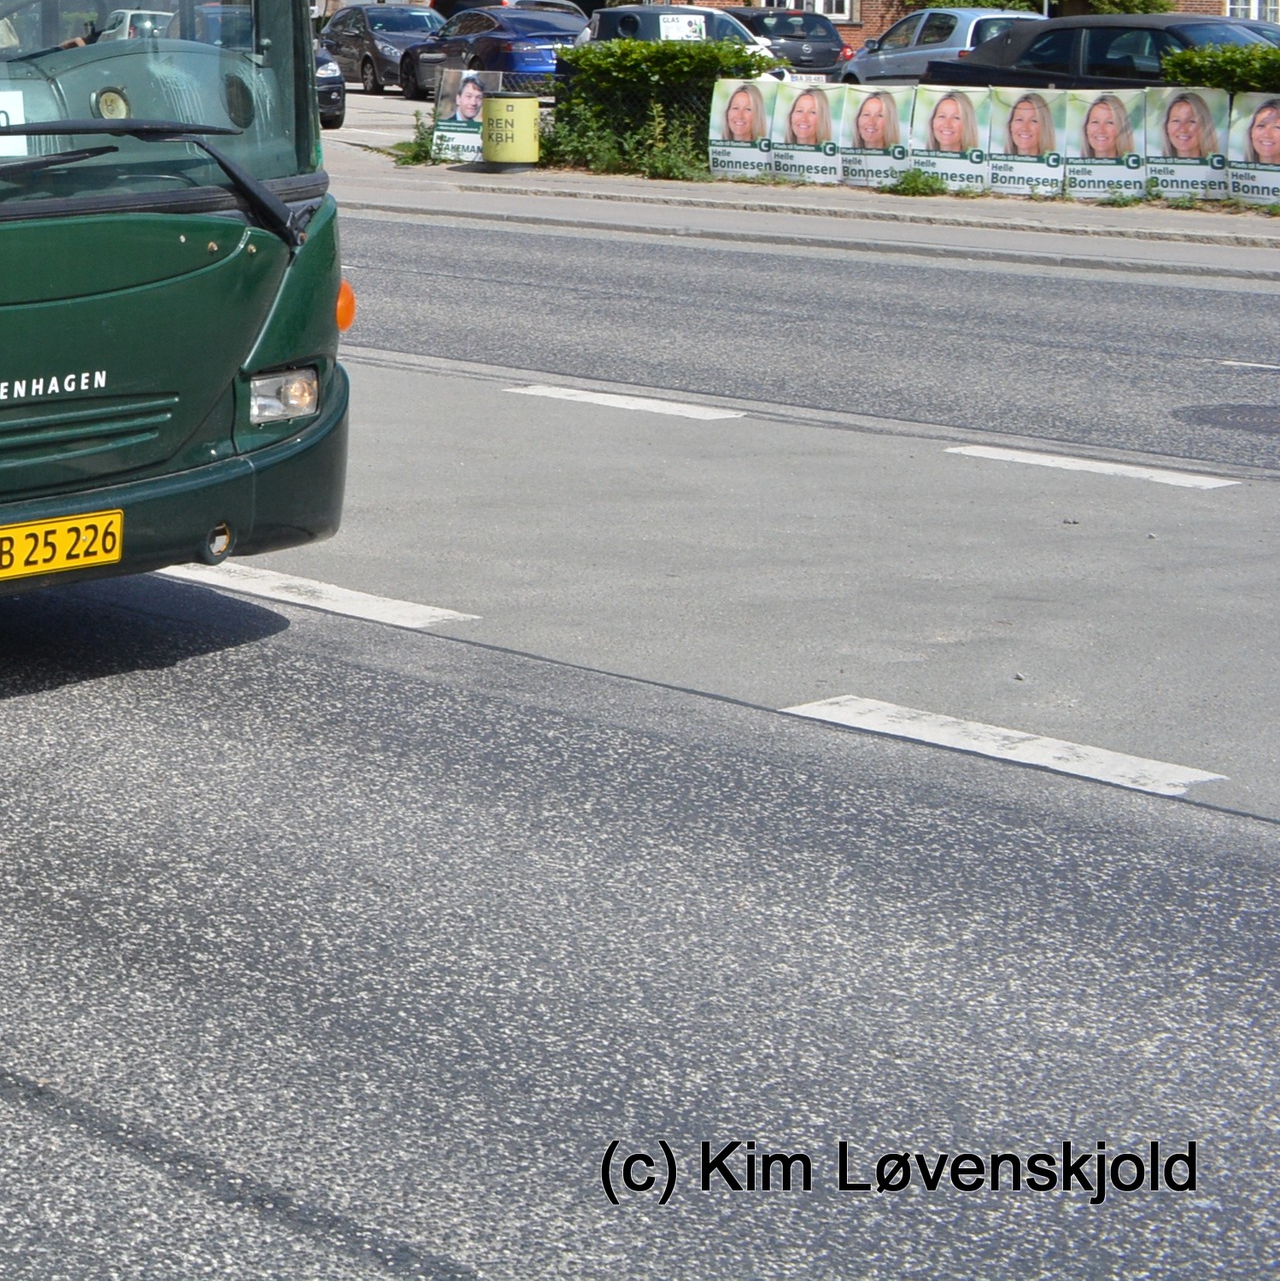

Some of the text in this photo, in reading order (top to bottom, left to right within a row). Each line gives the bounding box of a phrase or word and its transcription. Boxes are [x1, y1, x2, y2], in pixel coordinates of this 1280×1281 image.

[487, 119, 514, 129] REN
[487, 132, 514, 143] KBH
[760, 140, 769, 150] C
[825, 144, 834, 154] C
[712, 149, 731, 157] Helle
[774, 152, 794, 160] Helle
[894, 148, 902, 158] C
[971, 152, 980, 162] C
[712, 157, 772, 170] Bonnesen
[842, 157, 862, 165] Helle
[914, 159, 936, 168] Helle
[1049, 155, 1057, 166] C
[1129, 156, 1138, 167] C
[1213, 156, 1222, 167] C
[774, 160, 837, 175] Bonnesen
[991, 163, 1013, 172] Helle
[1068, 168, 1092, 176] Helle
[1149, 167, 1175, 176] Helle
[991, 172, 1059, 187] Bonnesen
[1231, 172, 1257, 181] Helle
[1068, 177, 1143, 190] Bonnesen
[1150, 176, 1227, 191] Bonnesen
[23, 528, 57, 567] 25
[66, 519, 117, 560] 226
